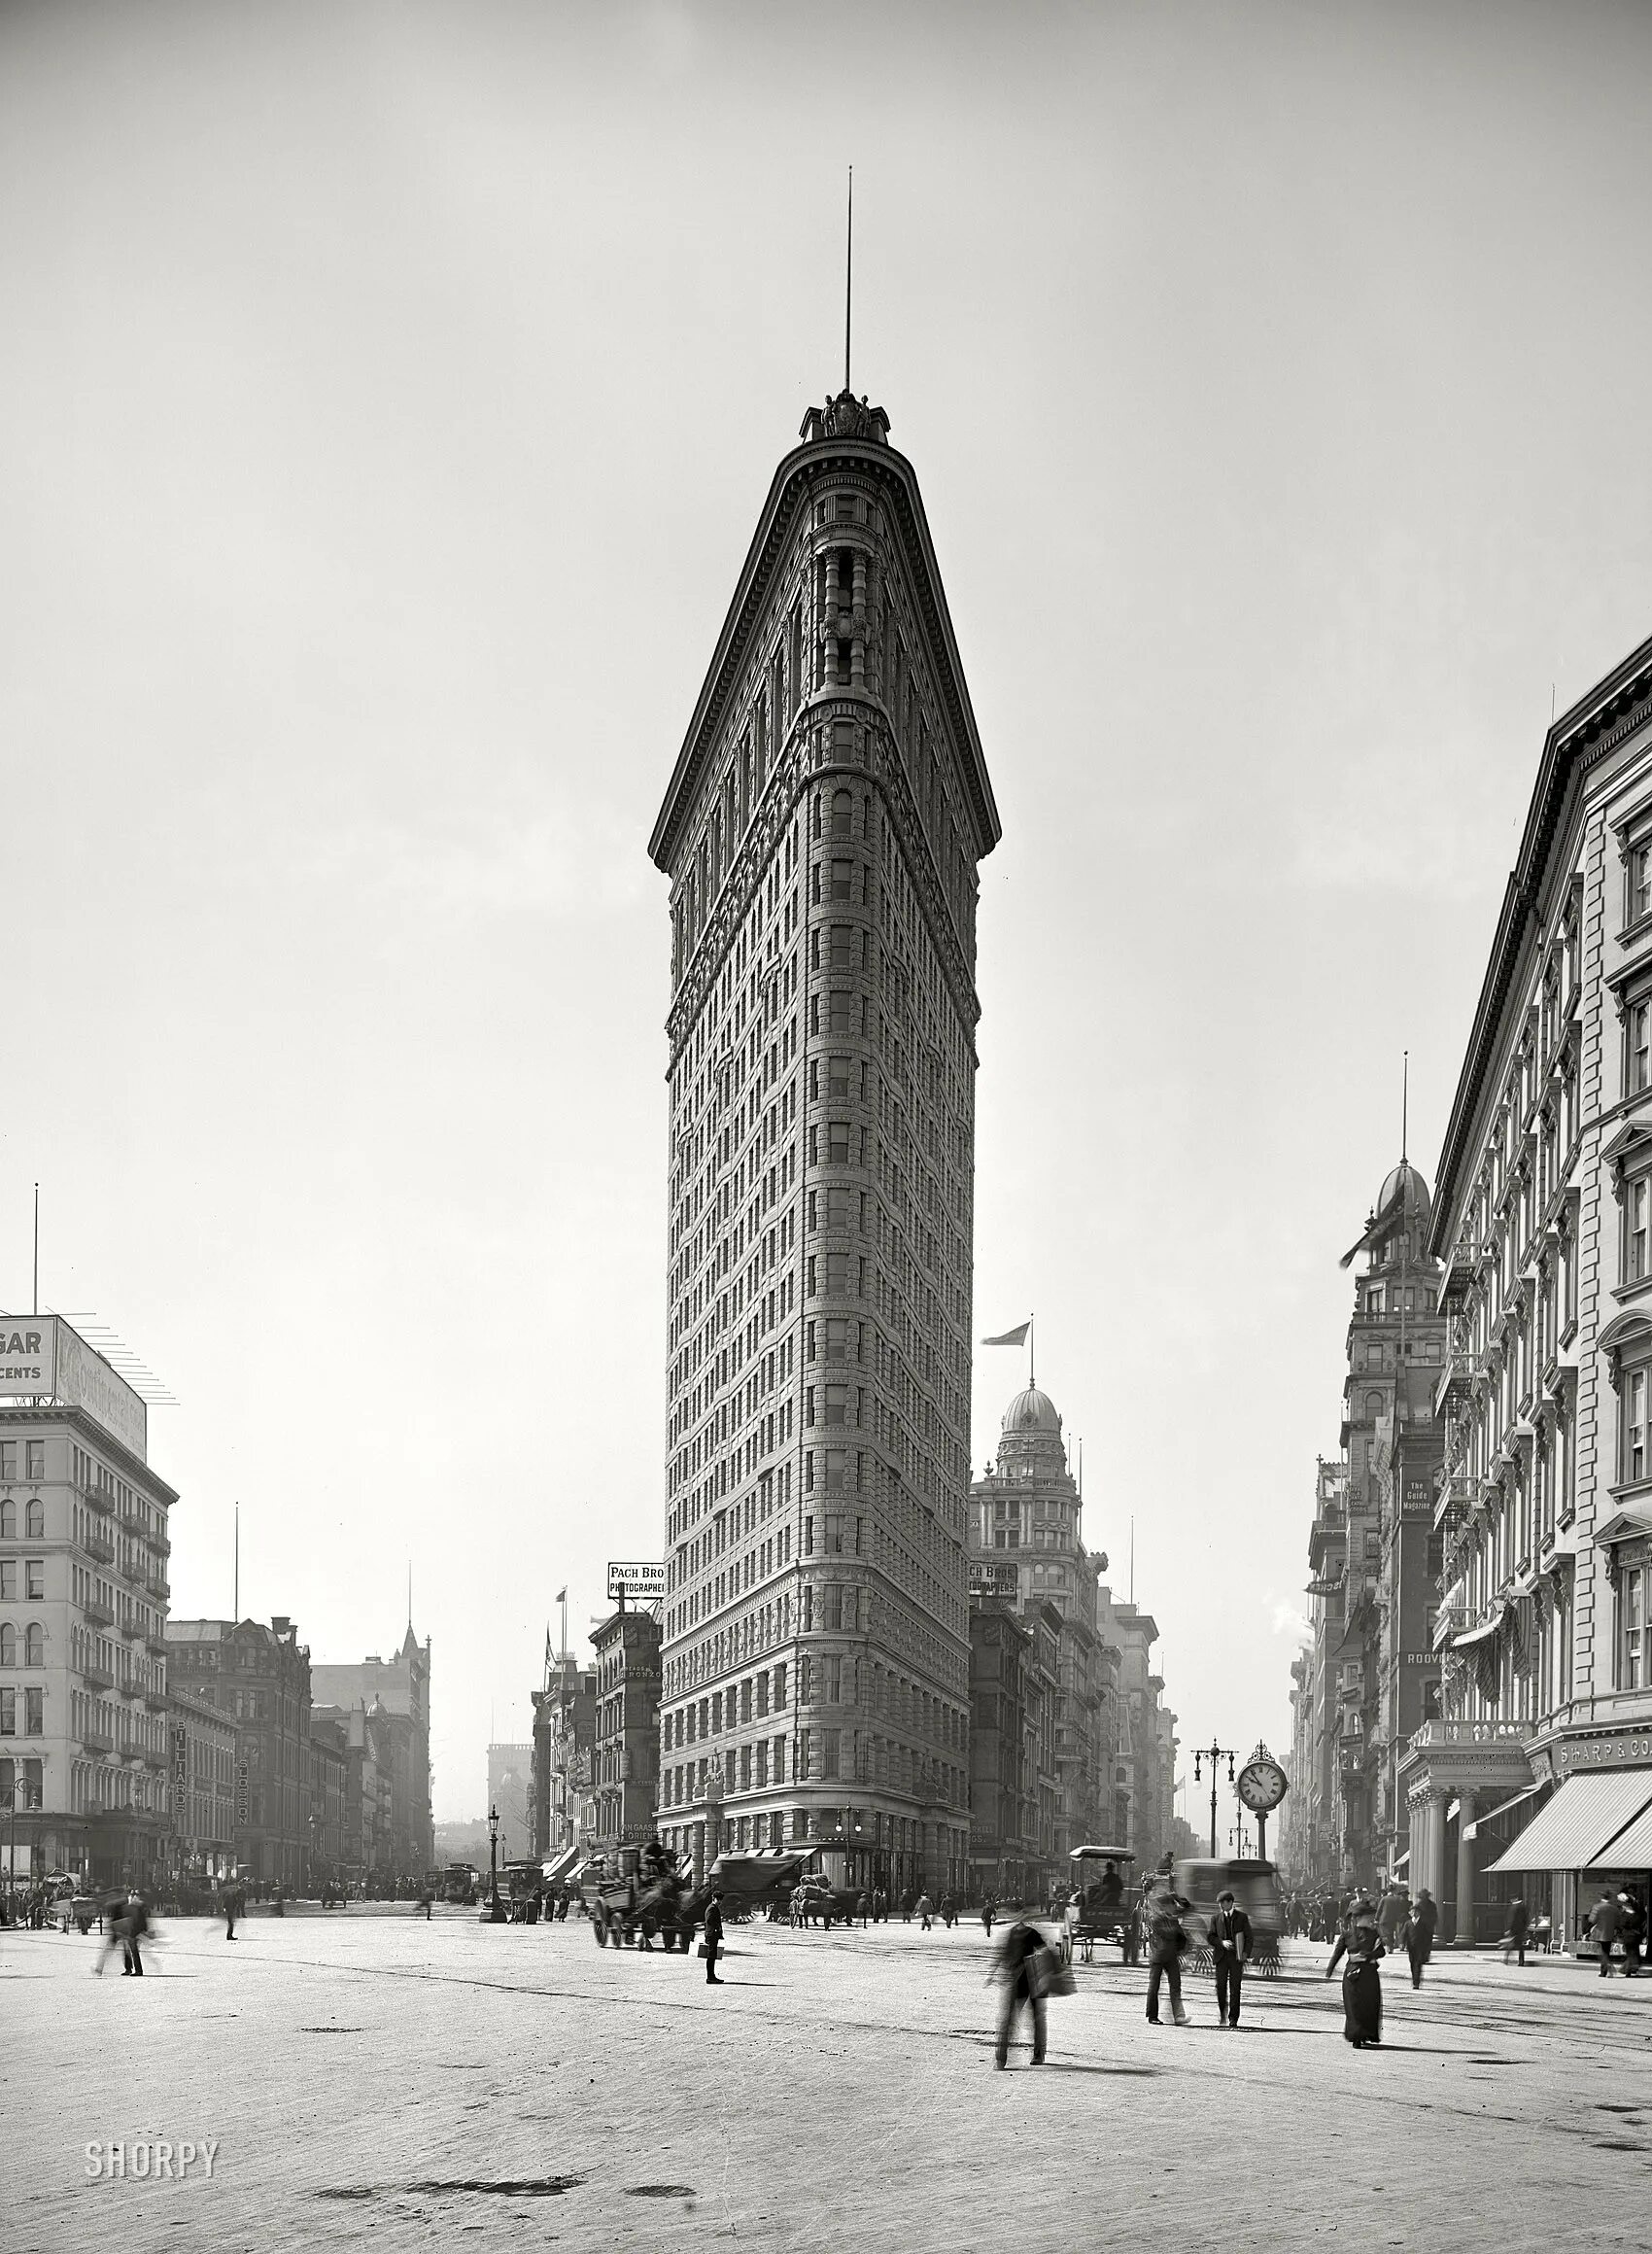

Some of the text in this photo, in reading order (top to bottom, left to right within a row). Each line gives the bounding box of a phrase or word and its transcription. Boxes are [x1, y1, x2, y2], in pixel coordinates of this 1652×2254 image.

[1407, 1491, 1428, 1500] Guide
[1403, 1502, 1430, 1510] Magazine
[610, 1583, 664, 1592] PHTOGRAPHE
[1561, 1745, 1612, 1762] SHARP
[1617, 1743, 1626, 1757] &
[176, 1720, 186, 1813] BILLIARDS
